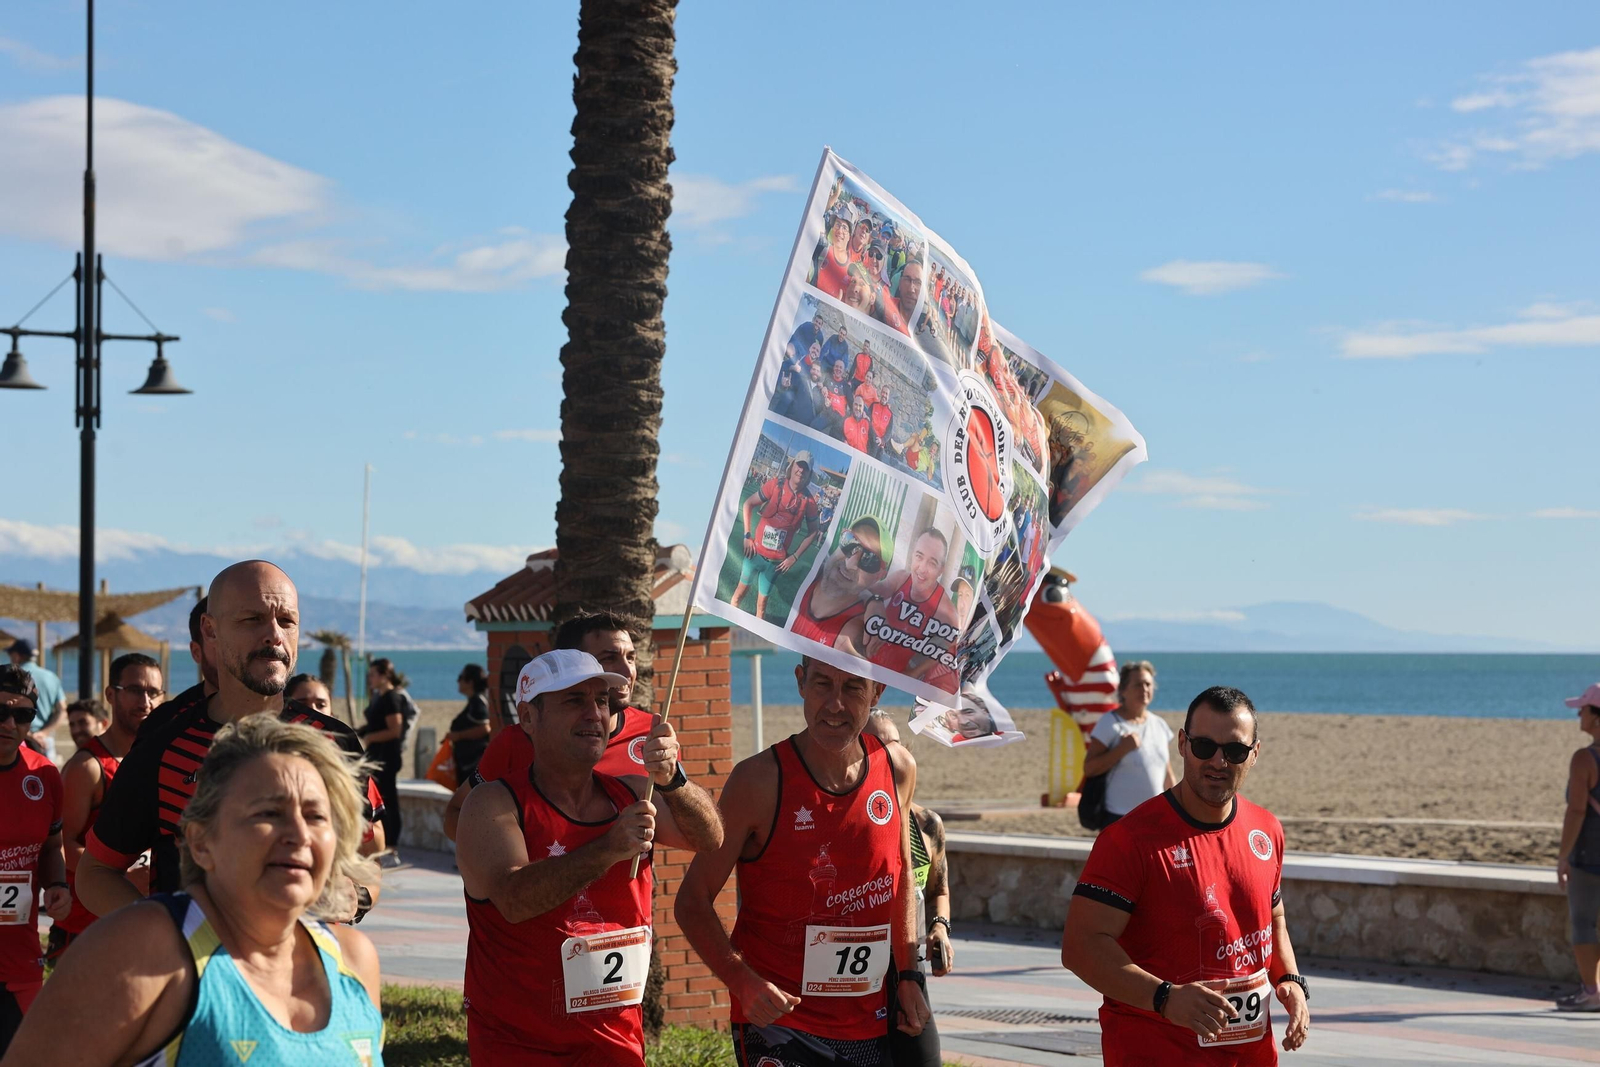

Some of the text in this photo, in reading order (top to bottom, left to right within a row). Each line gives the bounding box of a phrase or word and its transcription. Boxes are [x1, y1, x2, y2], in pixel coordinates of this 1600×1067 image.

[957, 475, 977, 520] CLUB
[899, 601, 960, 643] Va por
[865, 615, 958, 670] Corredores
[794, 823, 815, 831] luanvi
[0, 843, 42, 860] REDORES
[0, 885, 19, 909] 2
[826, 875, 893, 908] CORREDORES
[841, 888, 893, 916] CON MIGA
[602, 952, 624, 984] 2
[836, 946, 872, 976] 18
[1234, 949, 1258, 971] CON
[572, 998, 588, 1008] 024
[583, 988, 600, 996] VELASCO
[1225, 992, 1261, 1024] 29
